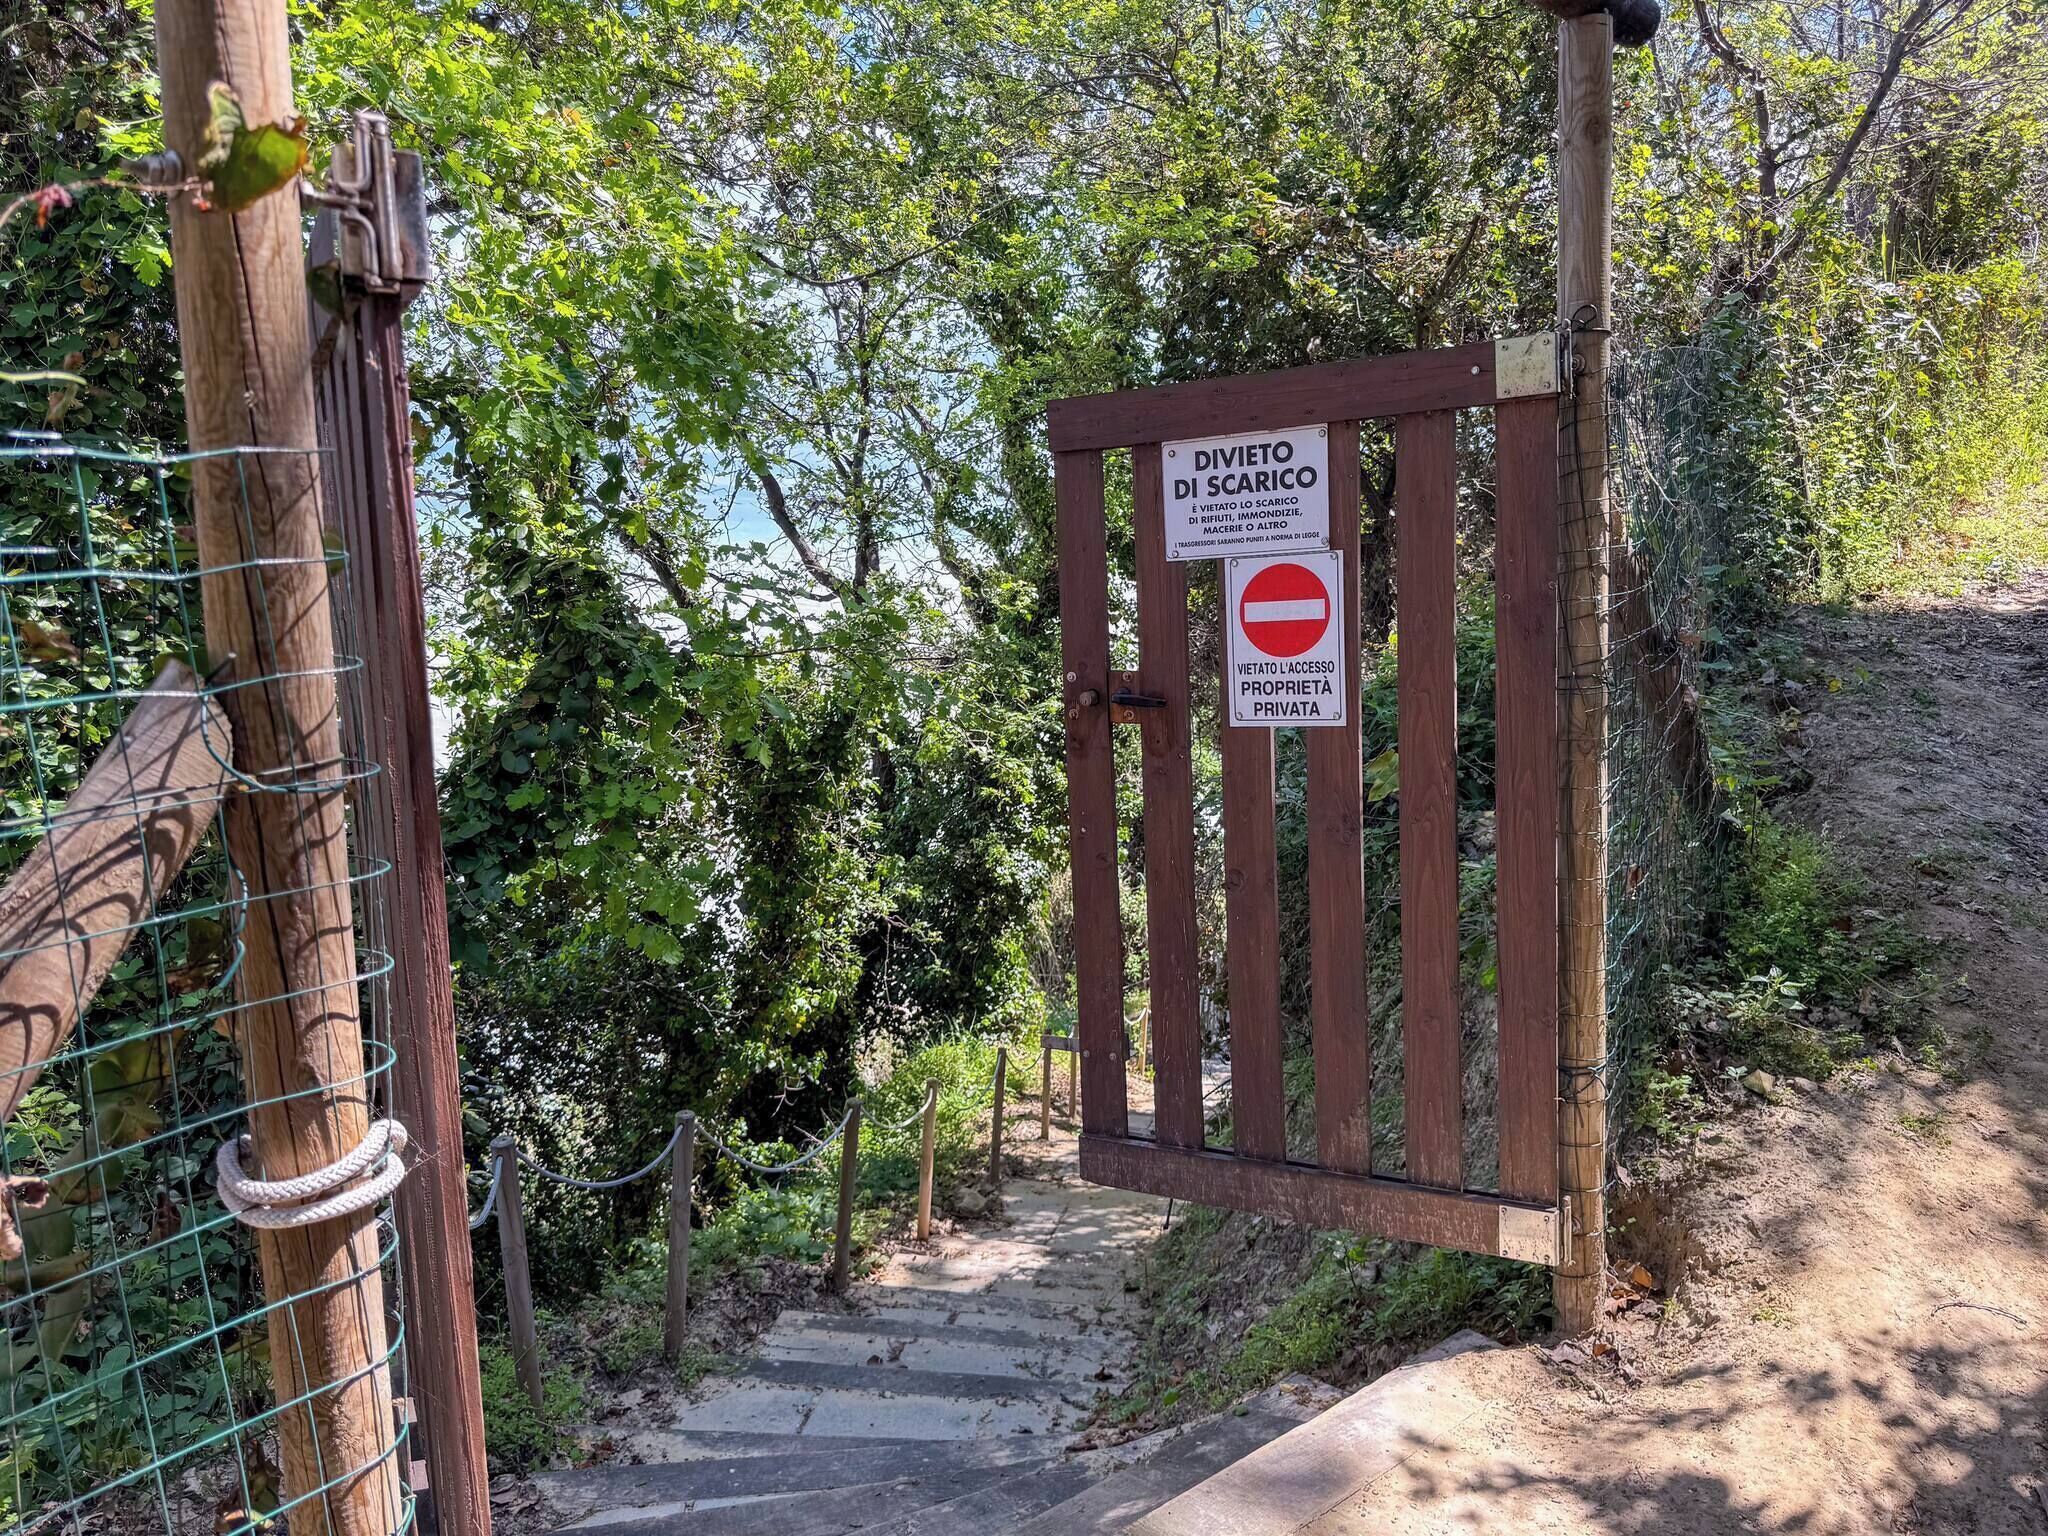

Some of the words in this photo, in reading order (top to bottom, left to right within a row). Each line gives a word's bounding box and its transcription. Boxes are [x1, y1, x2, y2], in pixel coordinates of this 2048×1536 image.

[1194, 441, 1294, 472] DIVIETO
[1174, 478, 1198, 500] DI
[1207, 466, 1318, 497] SCARICO
[1200, 502, 1237, 513] VIETATO
[1240, 500, 1253, 509] LO
[1255, 496, 1299, 508] SCARICO
[1188, 517, 1199, 525] DI
[1201, 514, 1235, 524] RIFIUTI,
[1238, 508, 1303, 521] IMMONDIZIE,
[1203, 525, 1243, 535] MACERIE
[1245, 523, 1255, 531] O
[1257, 521, 1288, 531] ALTRO
[1178, 539, 1217, 549] TRASGRESSORI
[1217, 537, 1245, 546] SARANNO
[1302, 531, 1320, 539] LEGGE
[1237, 662, 1277, 675] VIETATO
[1280, 660, 1335, 674] L'ACCESSO
[1241, 675, 1333, 696] PROPRIETÀ
[1253, 701, 1321, 717] PRIVATA
